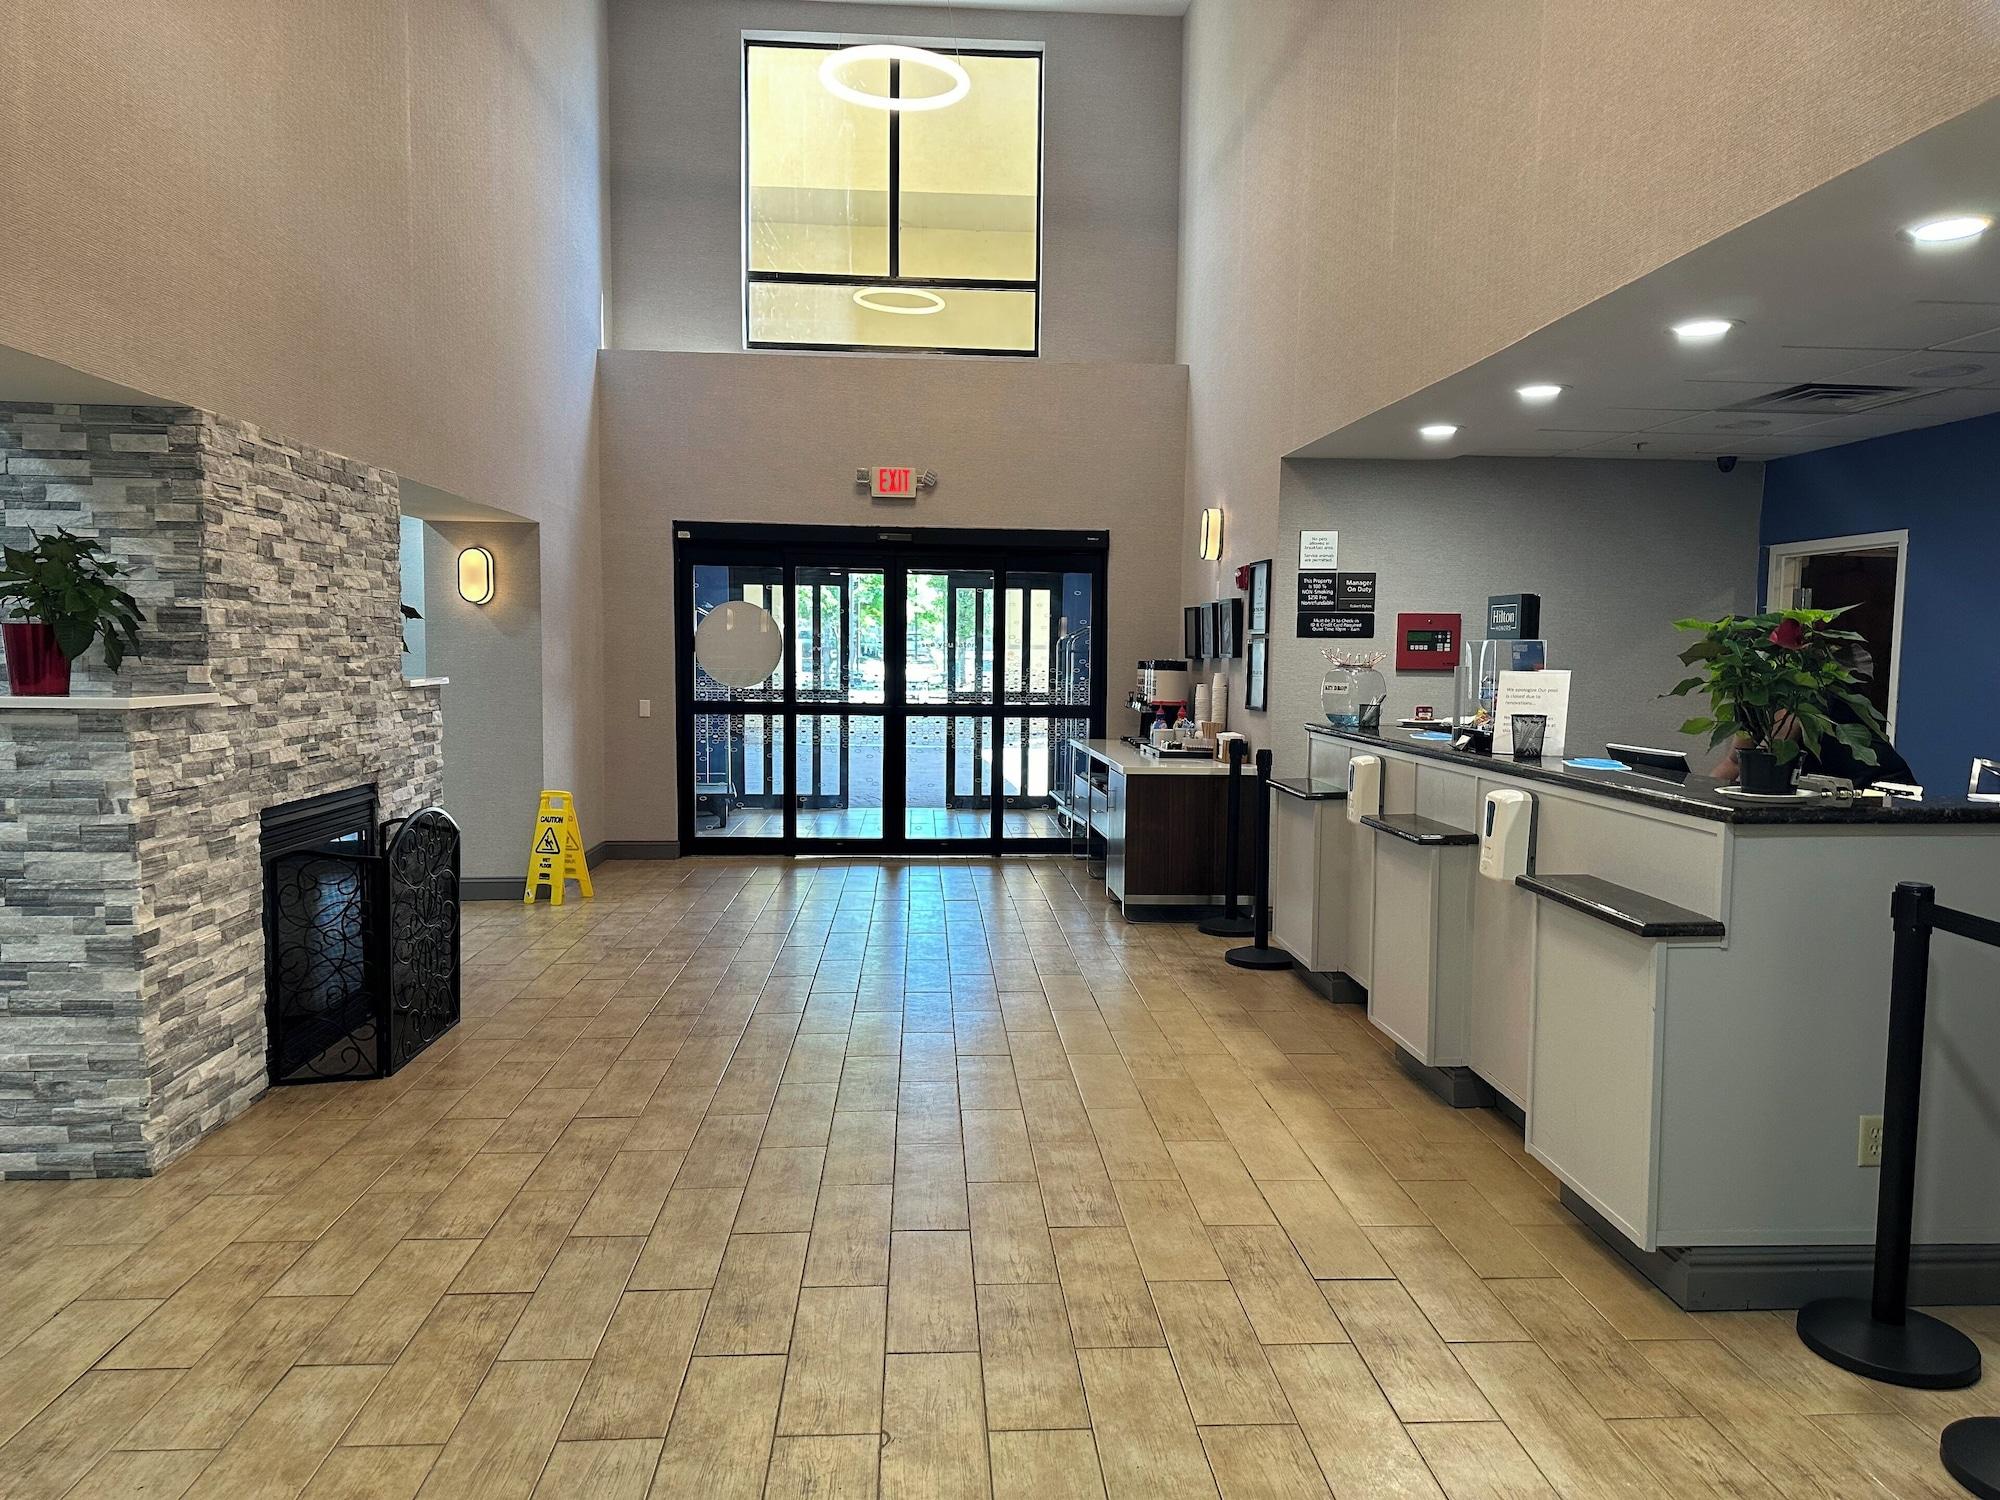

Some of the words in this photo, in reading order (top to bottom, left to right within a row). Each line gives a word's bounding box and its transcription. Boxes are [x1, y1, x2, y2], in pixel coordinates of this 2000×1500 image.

[879, 468, 910, 492] EXIT
[1346, 579, 1373, 587] Manager
[1357, 586, 1373, 594] Duty
[1492, 609, 1515, 624] Hilton
[540, 816, 564, 824] CAUTION
